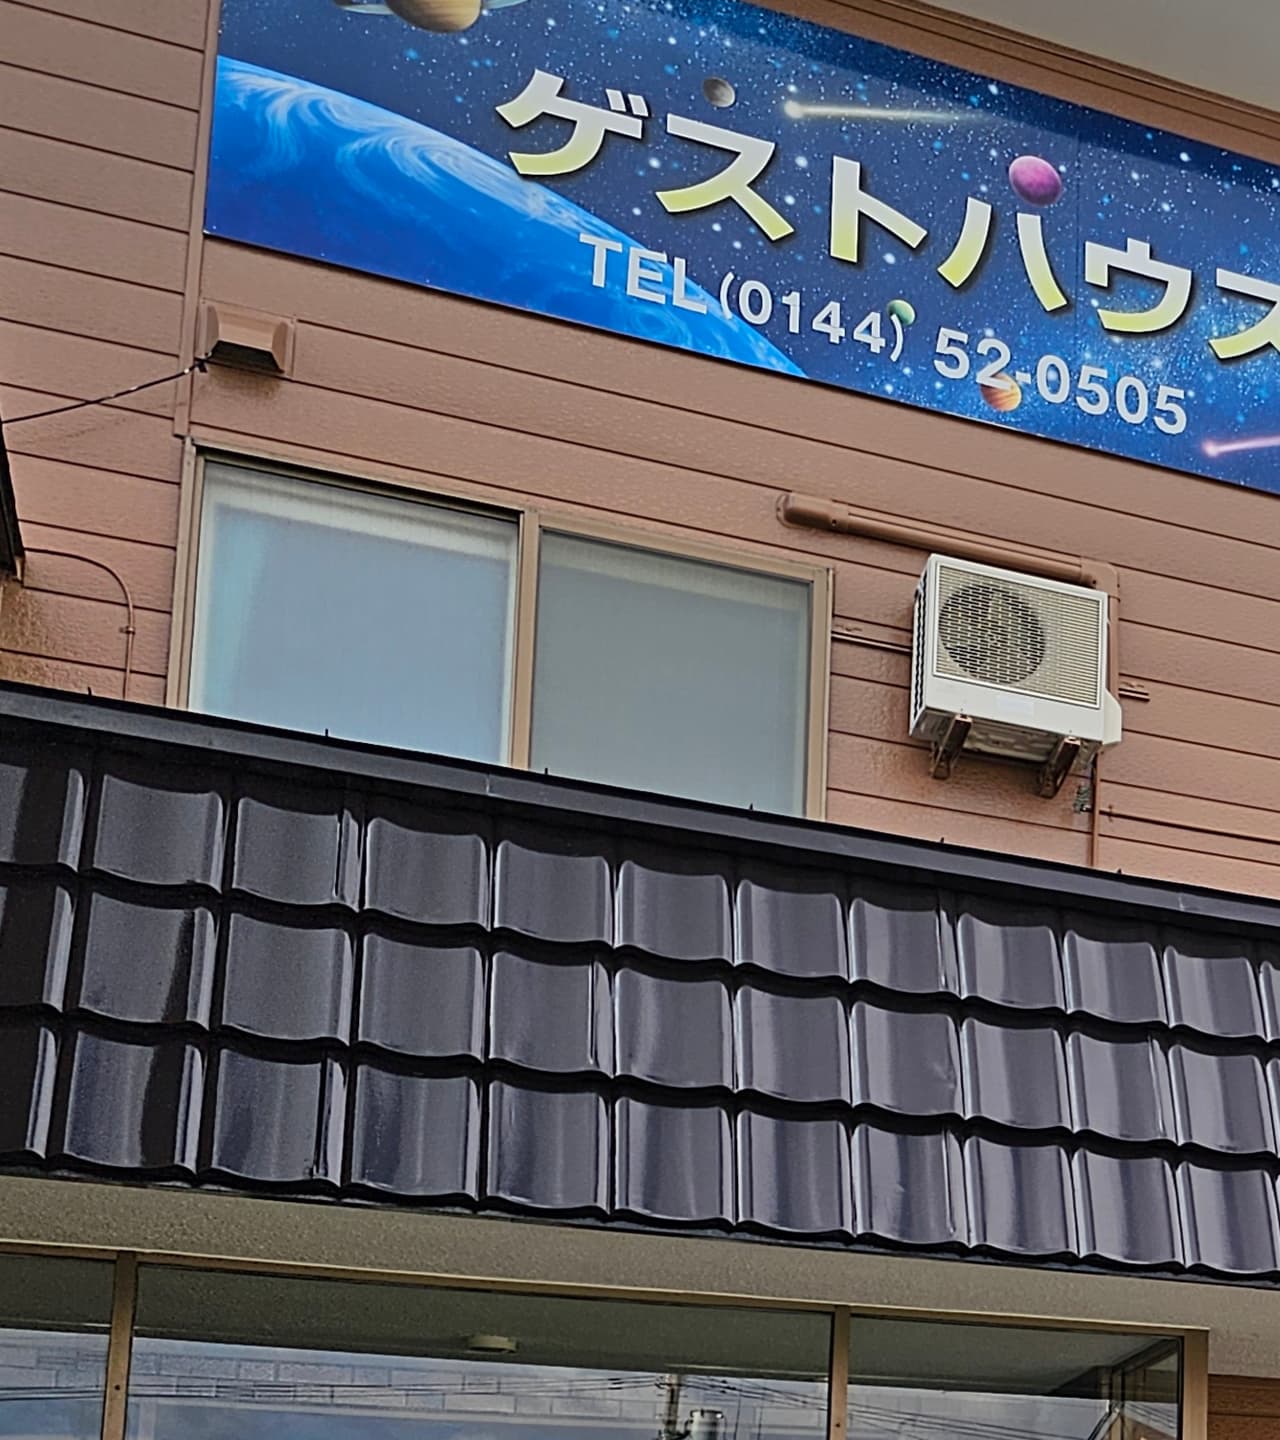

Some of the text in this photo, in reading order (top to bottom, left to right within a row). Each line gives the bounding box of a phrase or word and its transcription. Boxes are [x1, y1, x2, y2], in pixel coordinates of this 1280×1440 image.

[578, 233, 1188, 435] TEL (0144) 52-0505
